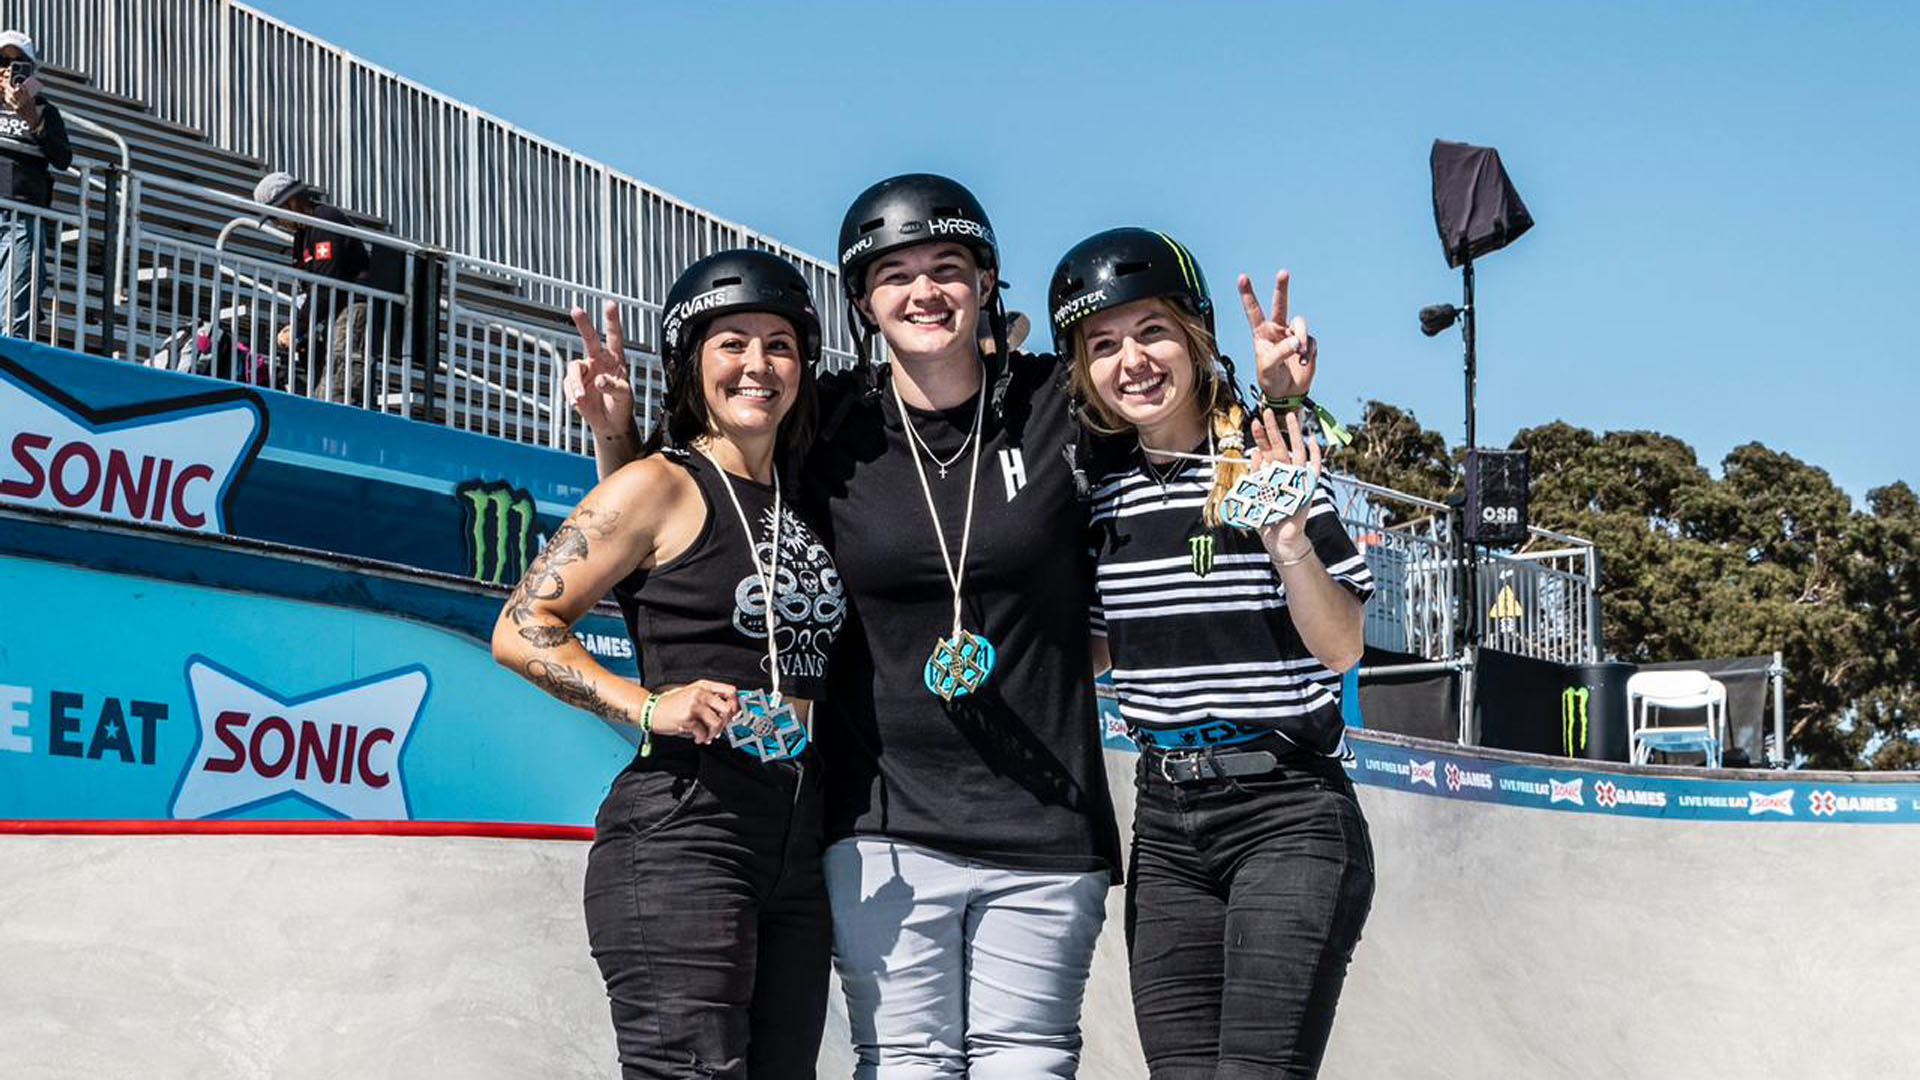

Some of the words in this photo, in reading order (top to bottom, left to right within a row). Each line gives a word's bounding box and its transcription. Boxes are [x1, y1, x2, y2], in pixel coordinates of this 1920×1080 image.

[681, 288, 726, 319] VANS
[0, 432, 214, 528] SONIC
[998, 448, 1027, 502] H
[1483, 506, 1517, 522] OSA
[779, 653, 824, 677] VANS
[49, 691, 169, 765] EAT
[203, 711, 394, 788] SONIC
